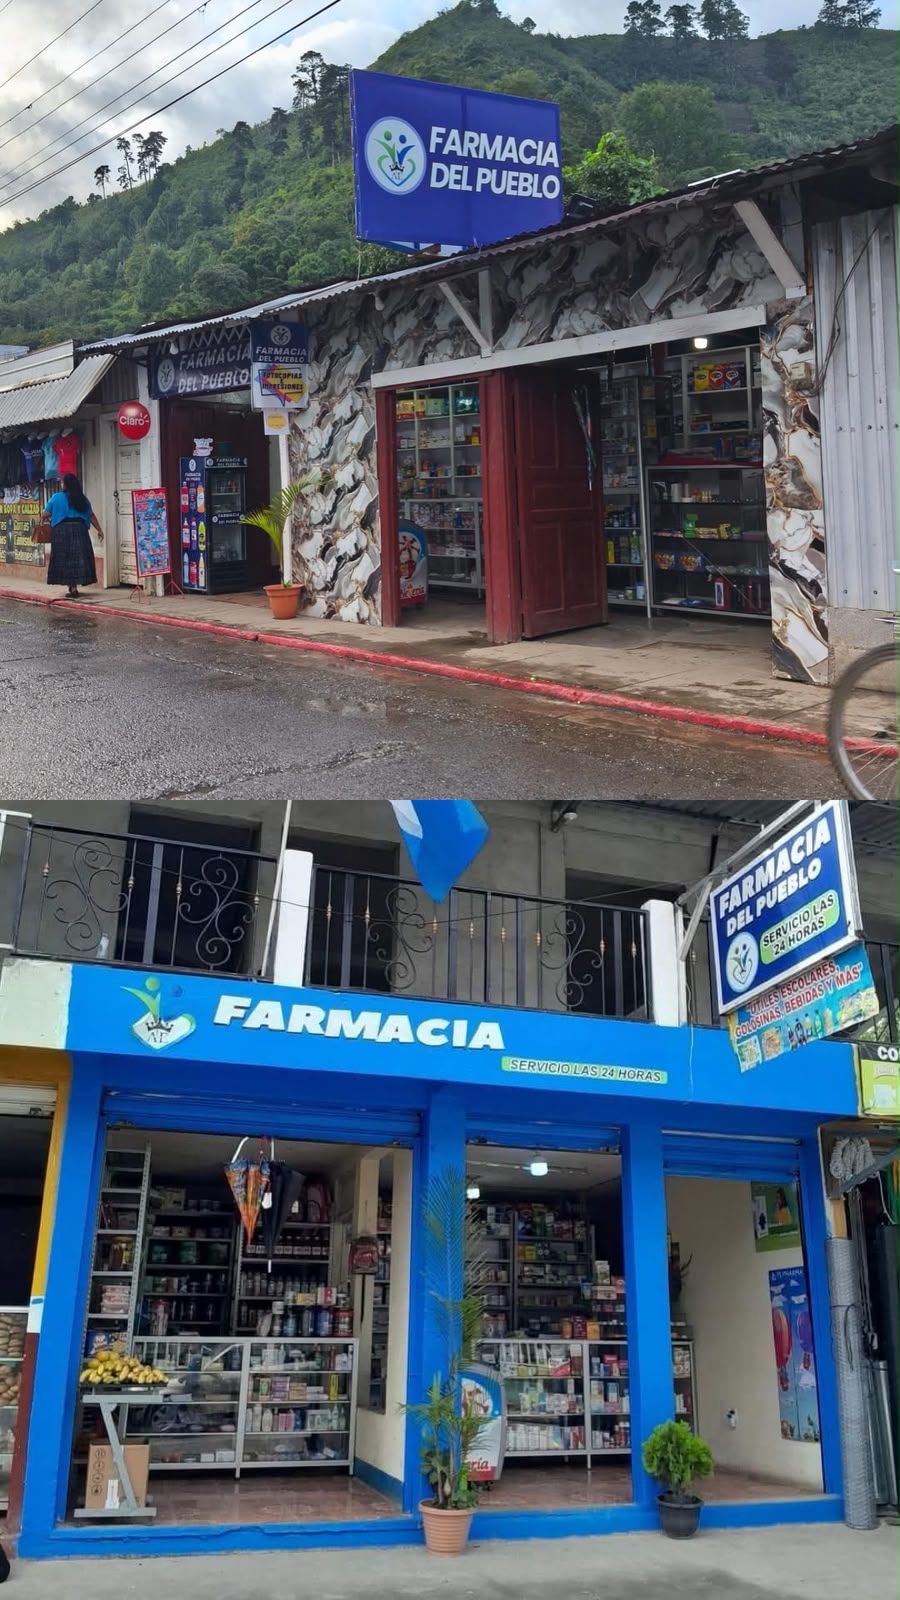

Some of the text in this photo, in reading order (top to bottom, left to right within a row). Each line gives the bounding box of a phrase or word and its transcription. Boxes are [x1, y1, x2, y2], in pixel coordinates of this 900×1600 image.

[429, 126, 560, 168] FARMACIA
[429, 162, 561, 200] DEL PUEBLO
[179, 342, 251, 371] FARMACIA
[255, 346, 307, 356] FARMACIA
[177, 368, 249, 394] DEL PUEBLO
[119, 415, 146, 426] Claro
[719, 816, 831, 920] FARMACIA
[726, 857, 822, 937] DEL PUEBLO
[762, 894, 834, 947] SERVICIO LAS
[773, 916, 825, 956] 24 HORAS
[784, 986, 825, 1014] BEBIDAS
[825, 981, 834, 993] Y
[212, 994, 505, 1051] FARMACIA
[510, 1059, 661, 1082] SERVICIO LAS 24 HORAS
[877, 1045, 900, 1062] CO
